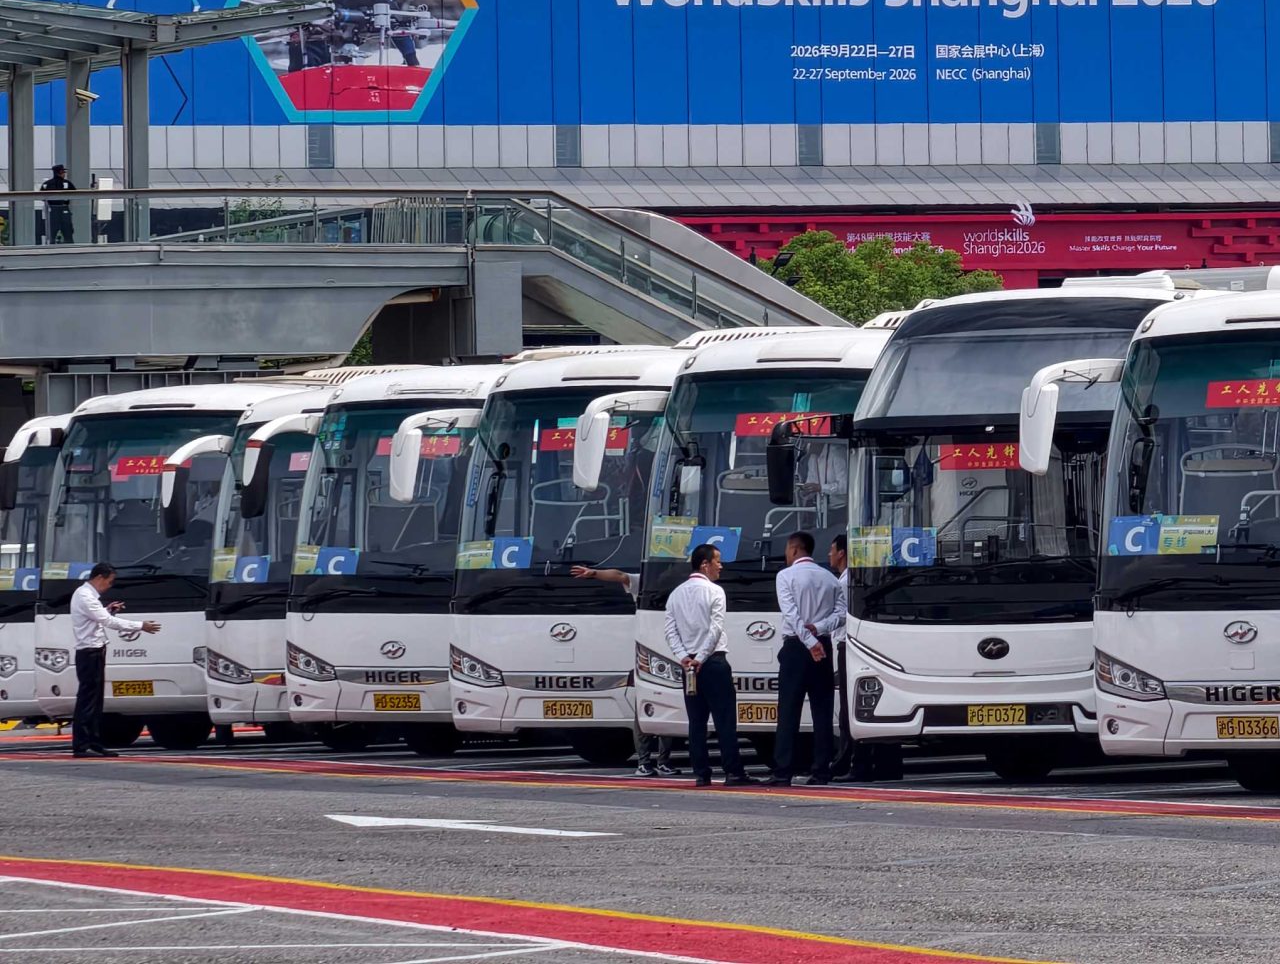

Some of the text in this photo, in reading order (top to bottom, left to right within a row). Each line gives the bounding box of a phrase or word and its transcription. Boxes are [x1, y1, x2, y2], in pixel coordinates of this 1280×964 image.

[792, 67, 1031, 81] 22-27 September 2026 NECC (Shanghai)
[963, 228, 1030, 242] worldskills
[952, 444, 1016, 460] 工人先锋
[1124, 526, 1146, 553] C
[501, 545, 519, 568] C
[900, 537, 920, 563] C
[242, 563, 259, 583] C
[328, 555, 345, 575] C
[22, 574, 36, 591] C
[113, 648, 148, 658] HIGER
[365, 670, 422, 683] HIGER
[535, 675, 595, 689] HIGER
[733, 677, 779, 691] HIGE
